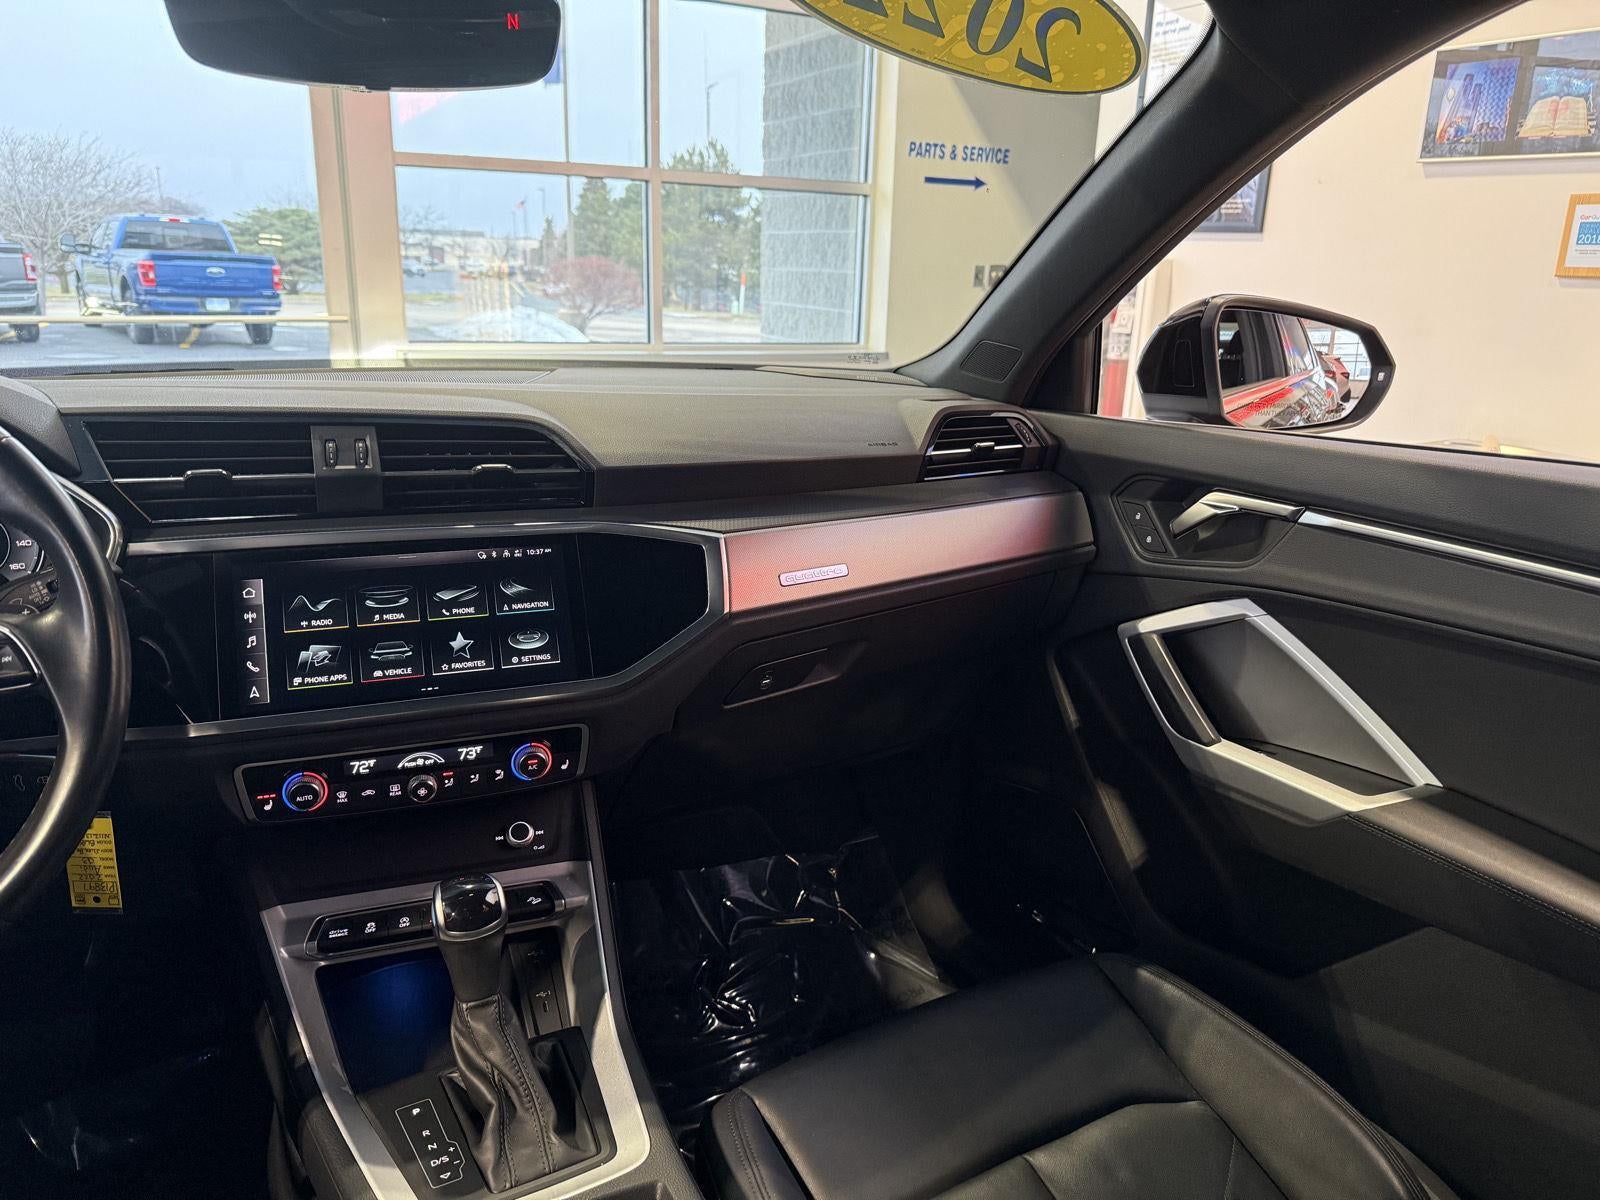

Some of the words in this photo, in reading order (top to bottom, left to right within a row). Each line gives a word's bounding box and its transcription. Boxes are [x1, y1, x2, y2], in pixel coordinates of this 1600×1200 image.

[507, 13, 519, 30] N
[908, 141, 946, 160] PARTS
[950, 144, 957, 161] &
[962, 145, 1010, 165] SERVICE
[15, 539, 32, 547] 140
[526, 548, 544, 556] 10:37
[9, 562, 26, 570] 160
[511, 601, 549, 610] NAVIGATION
[521, 653, 551, 662] SETTINGS
[451, 660, 486, 669] FAVORITES
[384, 667, 412, 676] VEHICLE
[304, 675, 329, 684] PHONE
[329, 673, 347, 681] APPS
[296, 794, 313, 802] AUTO
[427, 1142, 438, 1151] N
[430, 1155, 449, 1167] D/S
